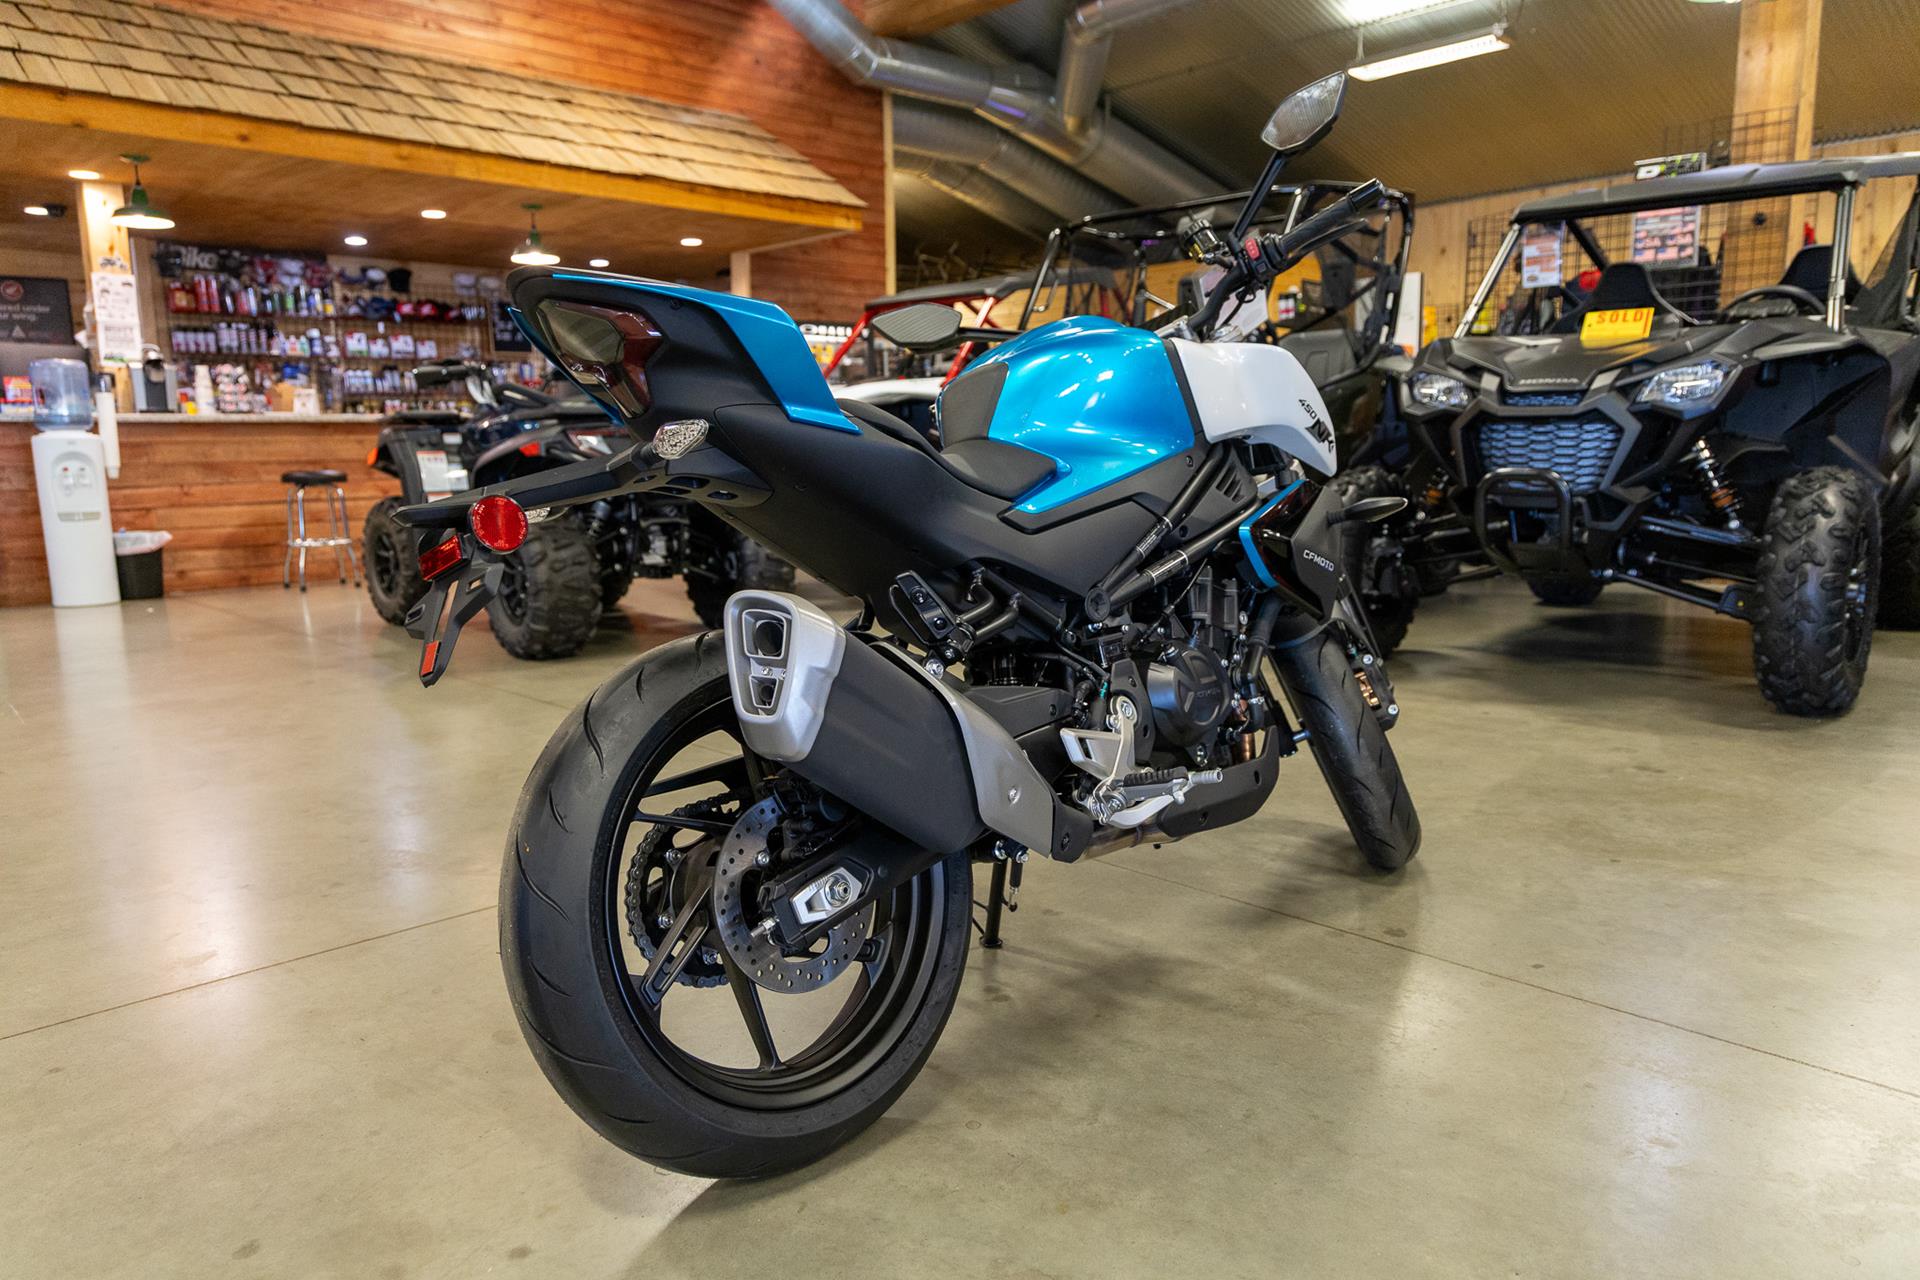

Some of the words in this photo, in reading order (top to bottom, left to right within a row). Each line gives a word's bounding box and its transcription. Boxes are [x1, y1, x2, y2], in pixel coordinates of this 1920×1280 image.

[1596, 309, 1644, 324] SOLD
[1298, 399, 1318, 420] 450
[1303, 549, 1335, 572] CFMOTO
